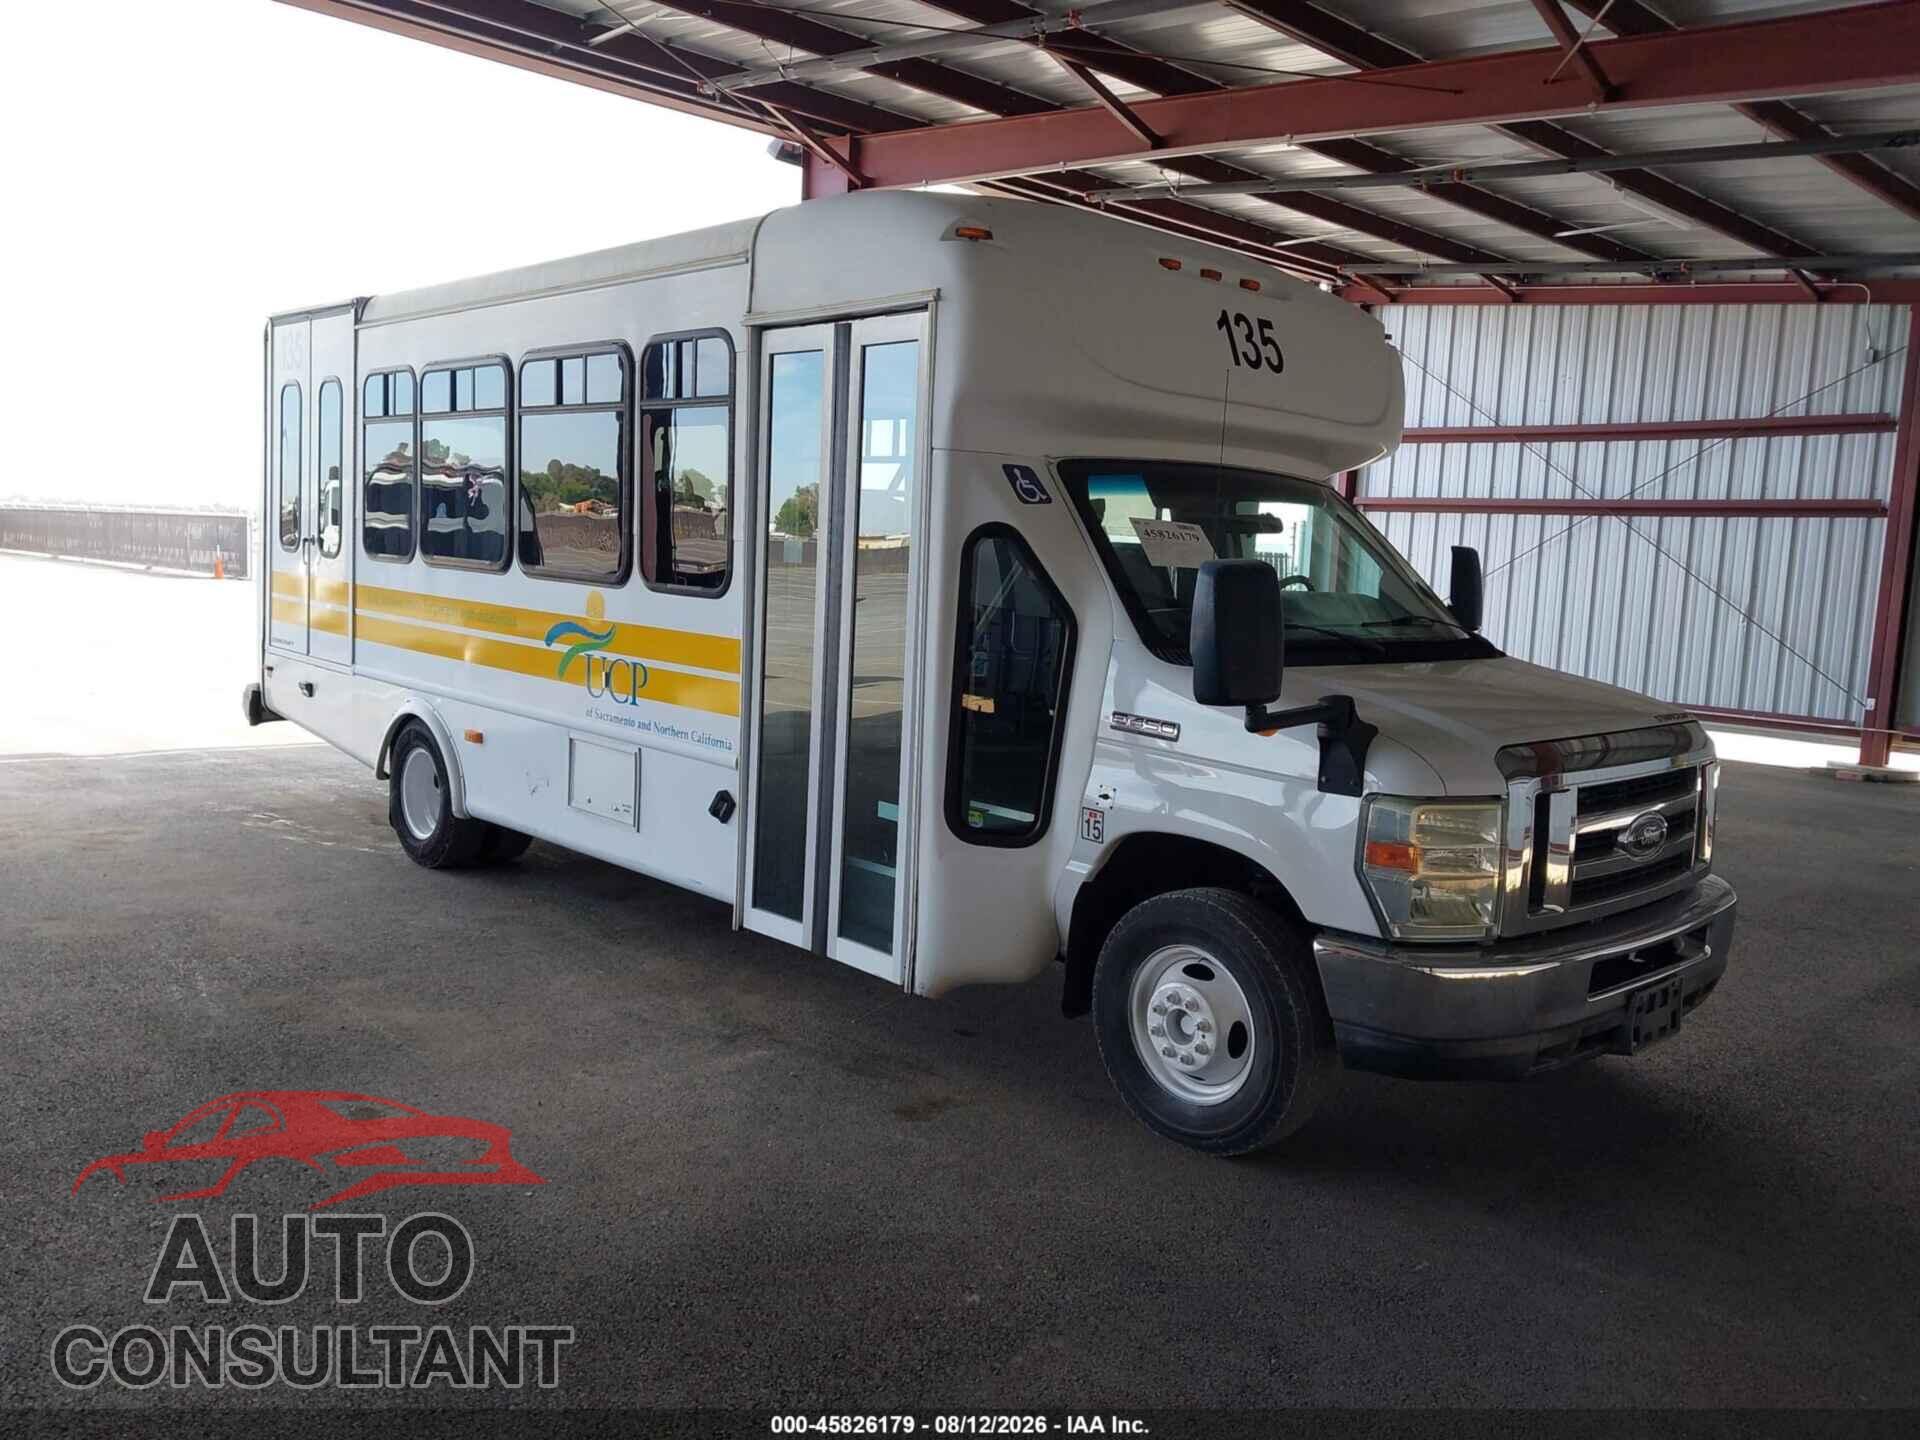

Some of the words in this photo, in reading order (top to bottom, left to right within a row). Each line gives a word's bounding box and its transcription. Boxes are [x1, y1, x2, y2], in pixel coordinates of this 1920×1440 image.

[1216, 308, 1284, 374] 135
[1143, 527, 1200, 545] 45826179
[585, 653, 648, 706] UCP
[594, 707, 636, 729] Sacramento
[637, 719, 652, 732] and
[653, 720, 690, 742] Northern
[690, 729, 733, 751] California
[1084, 818, 1102, 840] 15
